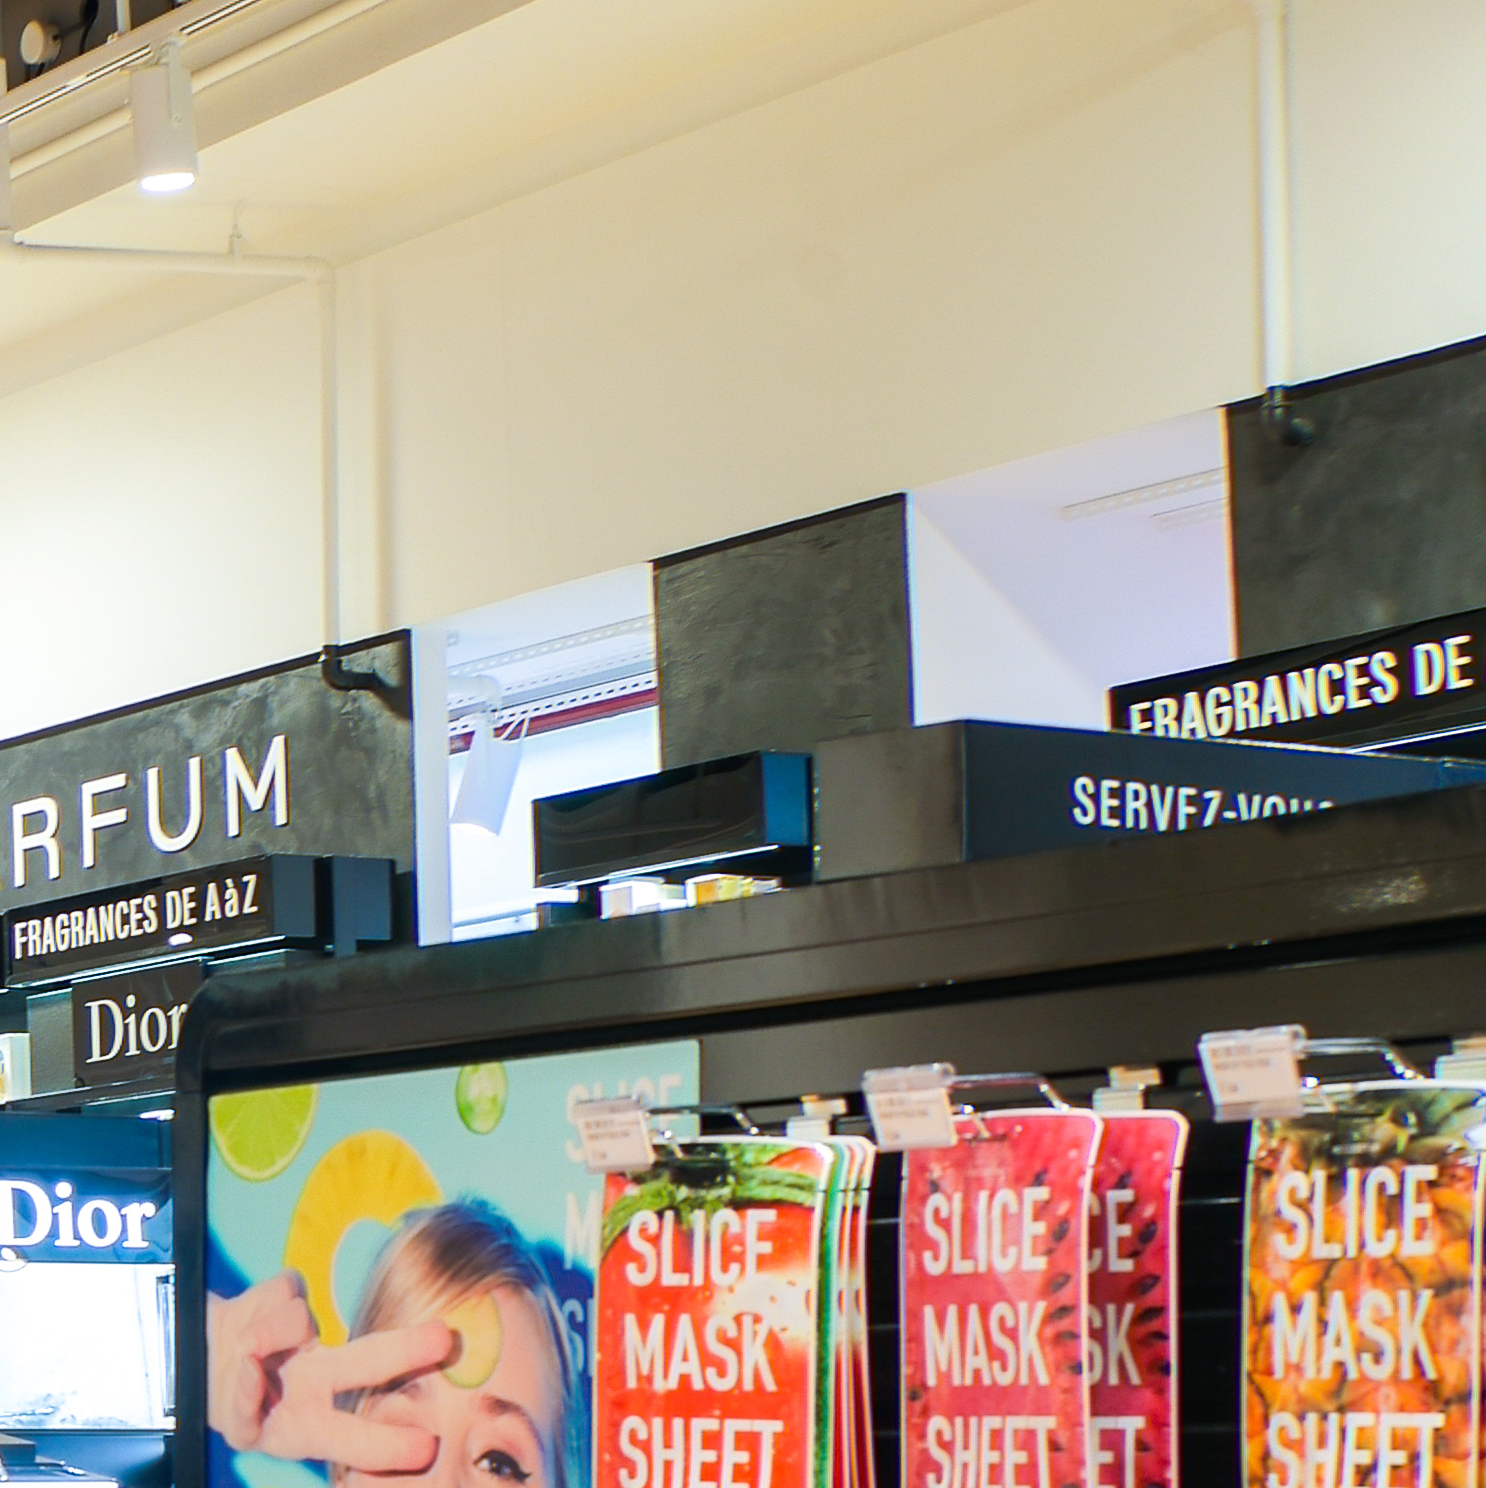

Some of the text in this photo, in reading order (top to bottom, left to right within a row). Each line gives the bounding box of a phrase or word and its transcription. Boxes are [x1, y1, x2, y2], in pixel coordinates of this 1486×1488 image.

[1127, 634, 1474, 740] FRAGRANCES DE
[13, 894, 158, 959] FRAGRANCES
[165, 887, 197, 929] DE
[84, 994, 188, 1063] Dior
[627, 1209, 777, 1287] SLICE
[922, 1186, 1050, 1276] SLICE
[1274, 1164, 1438, 1261] SLICE
[625, 1313, 777, 1392] MASK
[923, 1303, 1050, 1387] MASK
[1273, 1287, 1437, 1381] MASK
